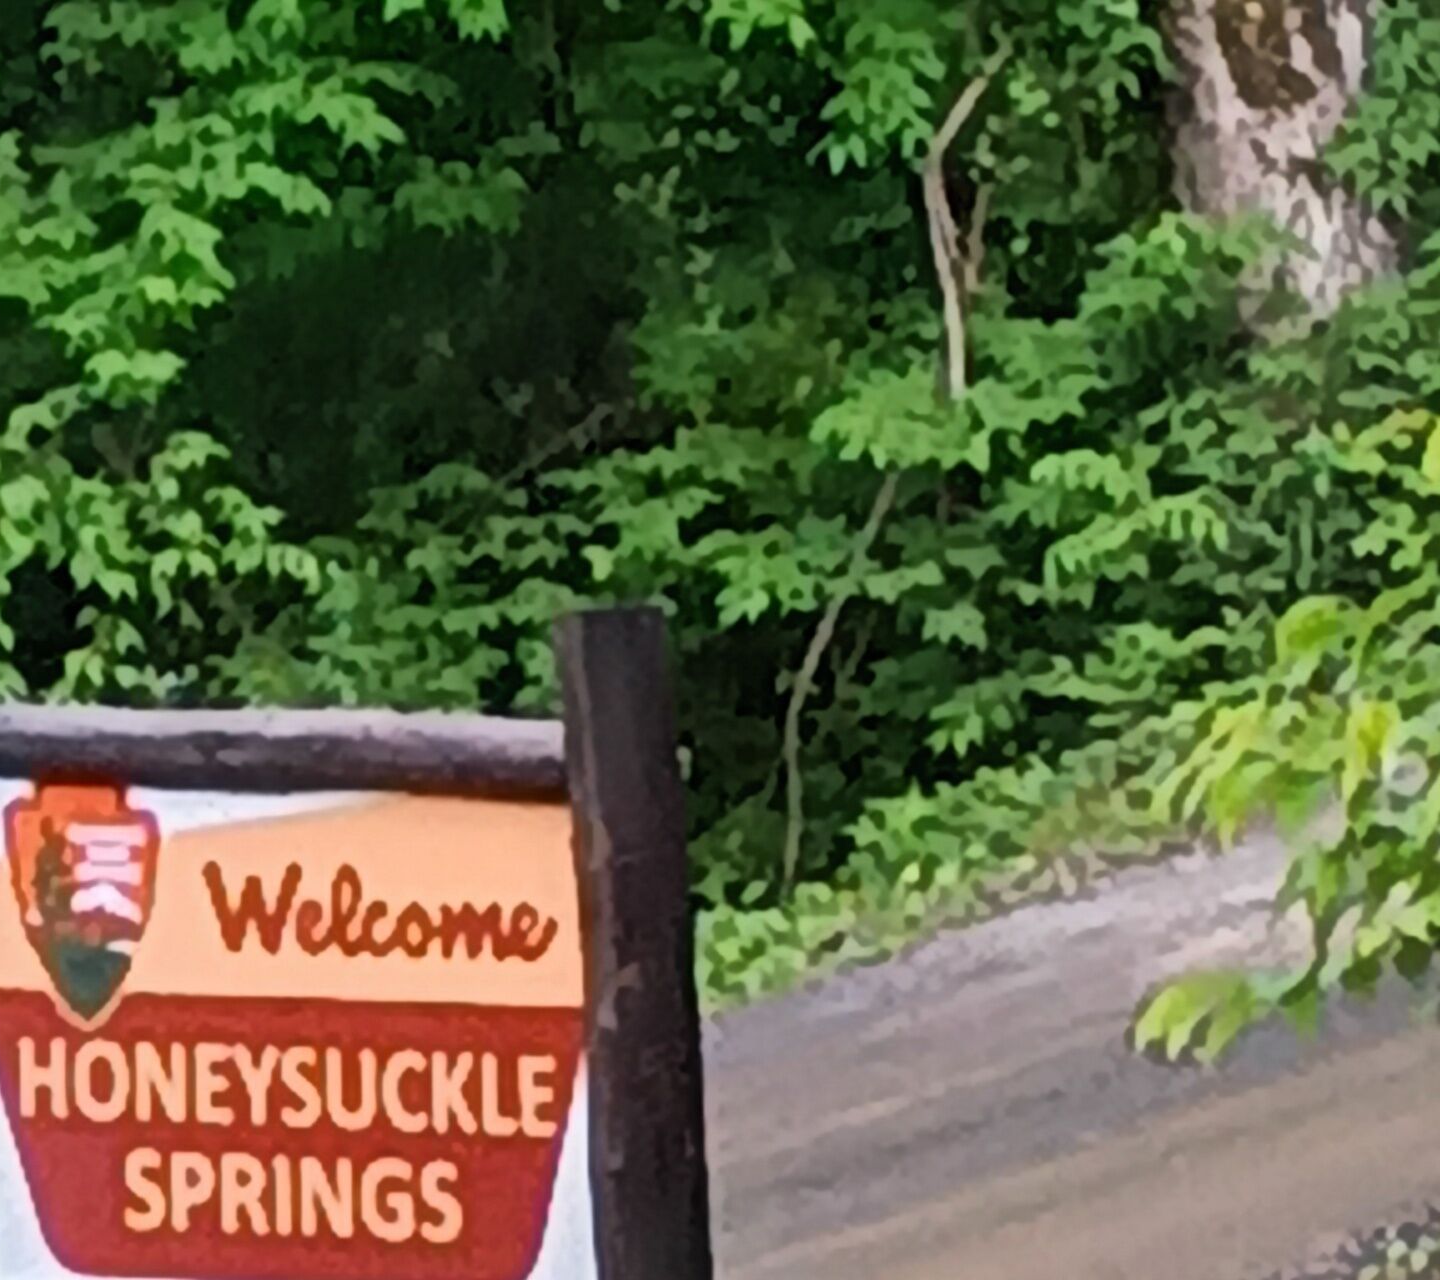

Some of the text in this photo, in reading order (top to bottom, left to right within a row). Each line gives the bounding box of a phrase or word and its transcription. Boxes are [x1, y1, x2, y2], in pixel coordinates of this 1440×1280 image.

[201, 861, 558, 961] Welcome
[16, 1037, 558, 1137] HONEYSUCKLE
[123, 1147, 464, 1243] SPRINGS
